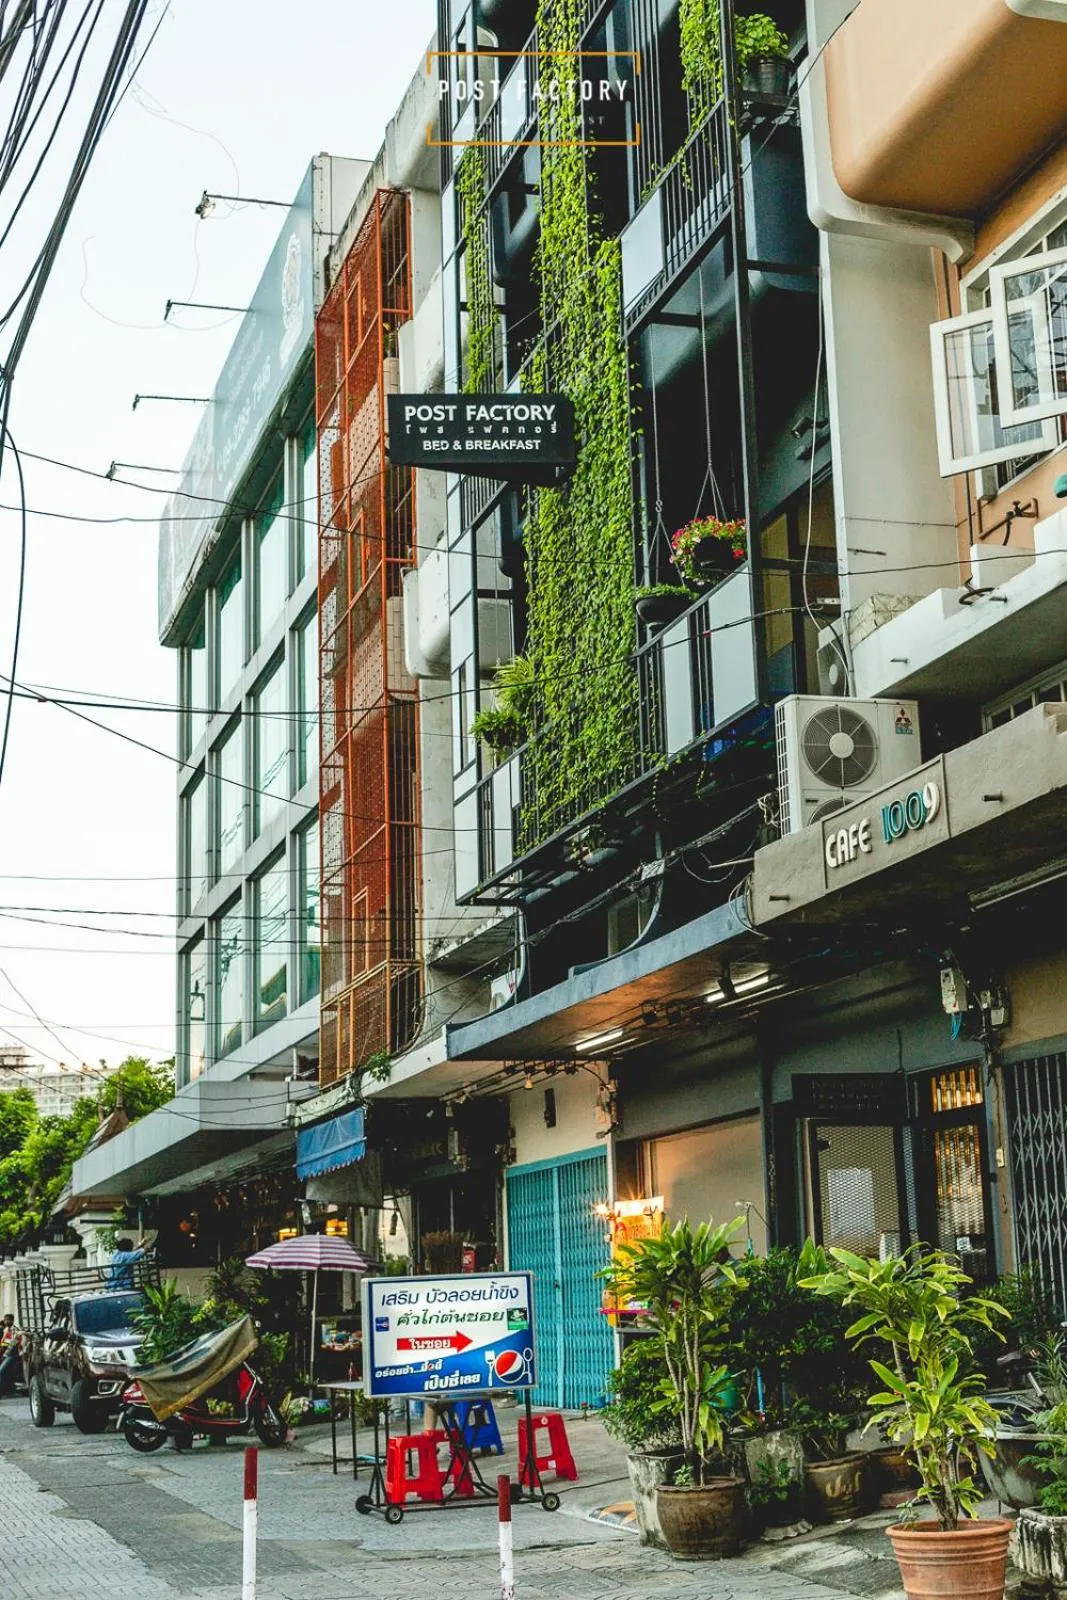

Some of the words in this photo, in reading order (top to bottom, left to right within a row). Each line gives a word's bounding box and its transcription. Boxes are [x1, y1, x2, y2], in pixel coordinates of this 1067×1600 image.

[404, 405, 457, 421] POST
[466, 404, 556, 421] FACTORY
[423, 440, 449, 450] BED
[452, 440, 462, 450] &
[465, 439, 541, 450] BREAKFAST
[825, 817, 873, 869] CAFE
[881, 782, 941, 845] 1009
[381, 1290, 419, 1306] เสริม
[426, 1281, 519, 1304] บัวลอยน้ำขิง
